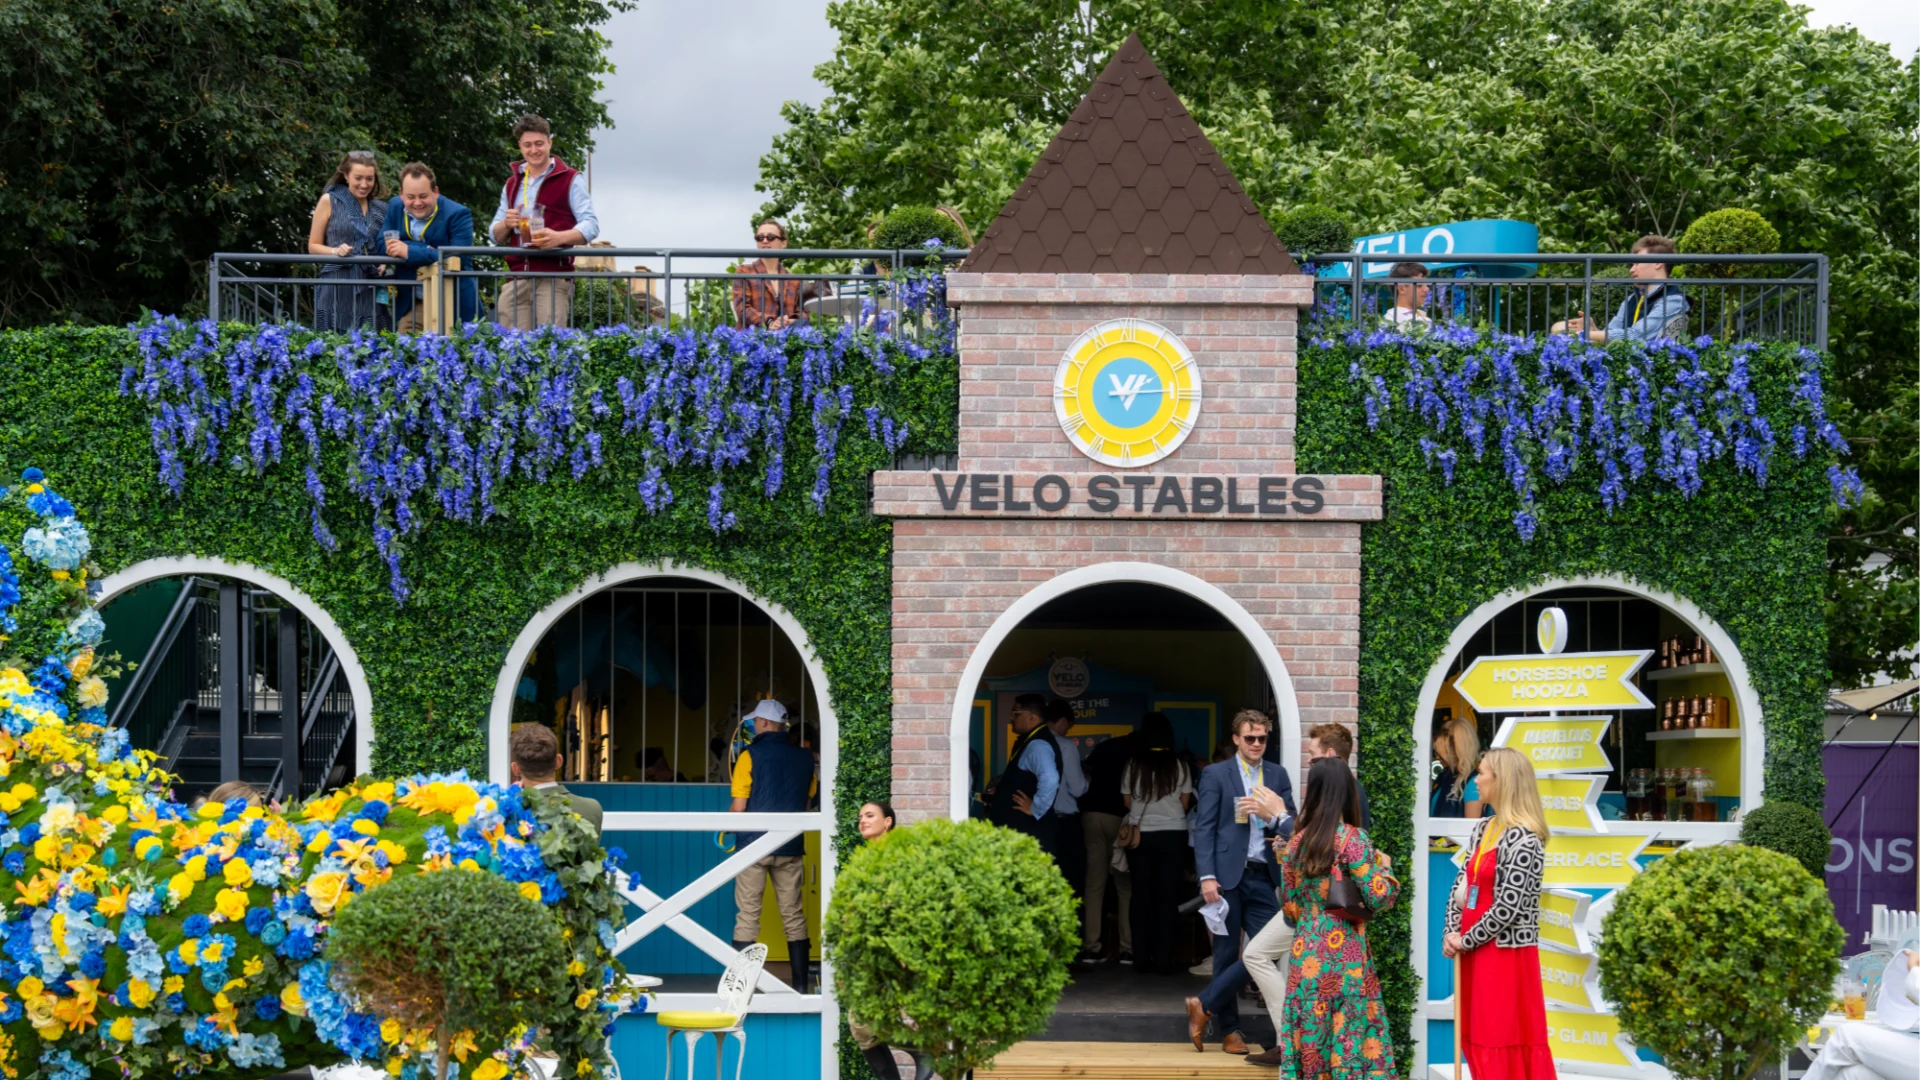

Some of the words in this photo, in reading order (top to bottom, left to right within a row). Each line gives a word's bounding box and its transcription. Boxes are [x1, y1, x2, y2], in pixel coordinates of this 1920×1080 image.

[933, 473, 1071, 512] VELO
[1087, 474, 1325, 514] STABLES
[1053, 673, 1085, 682] VELO
[1493, 665, 1608, 683] HORSESHOE
[1512, 683, 1588, 699] HOOPLA
[1088, 698, 1110, 708] THE
[1523, 729, 1593, 744] MARVELOUS
[1532, 746, 1585, 761] CROQUET
[1544, 852, 1623, 867] ERRACE
[1559, 1028, 1608, 1046] GLAM
